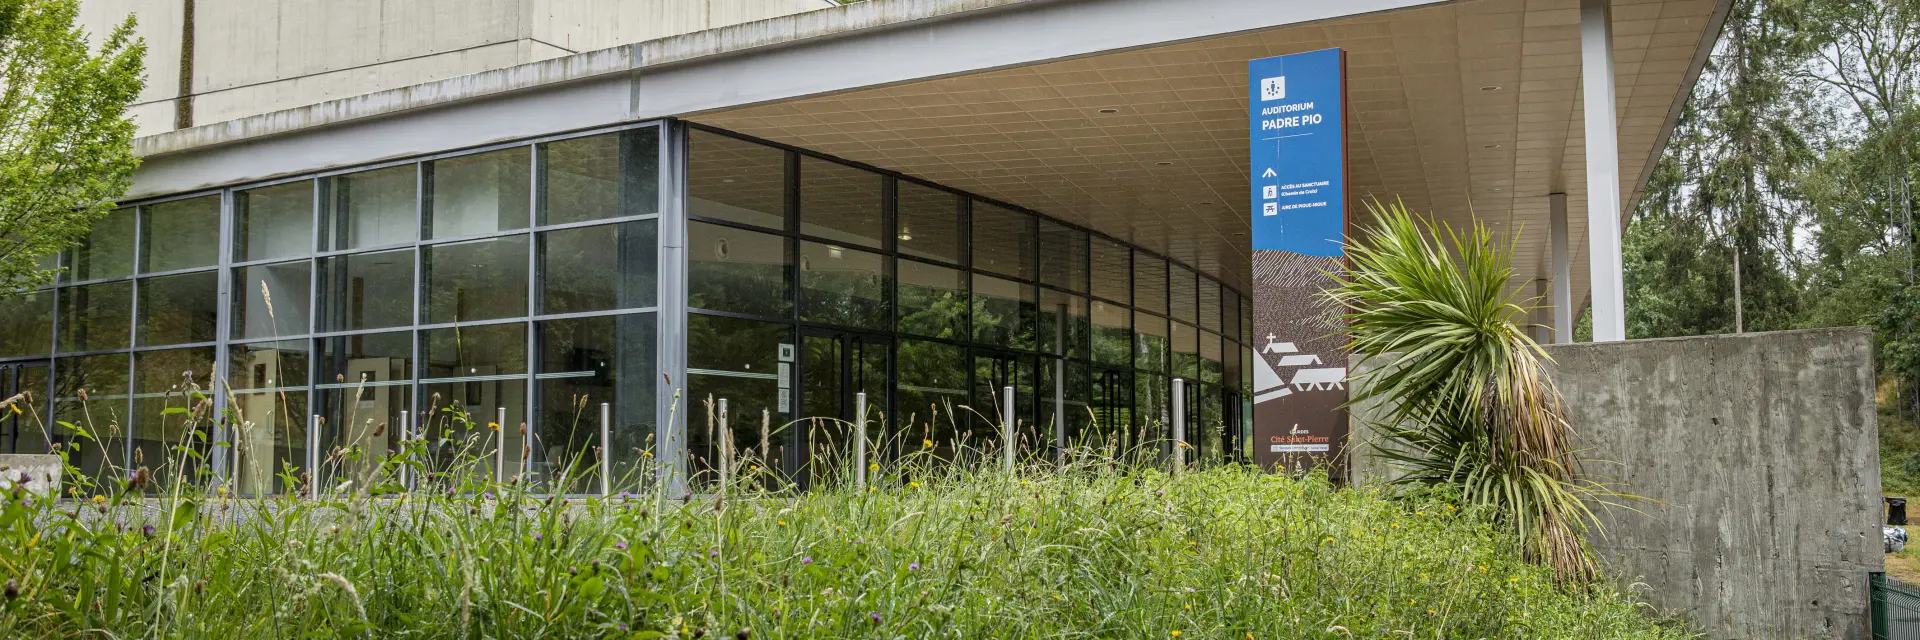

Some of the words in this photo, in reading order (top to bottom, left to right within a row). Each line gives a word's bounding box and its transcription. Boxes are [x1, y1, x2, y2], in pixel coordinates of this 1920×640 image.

[1262, 102, 1314, 116] AUDITORIUM
[1262, 116, 1300, 131] PADRE
[1302, 113, 1322, 126] PIO
